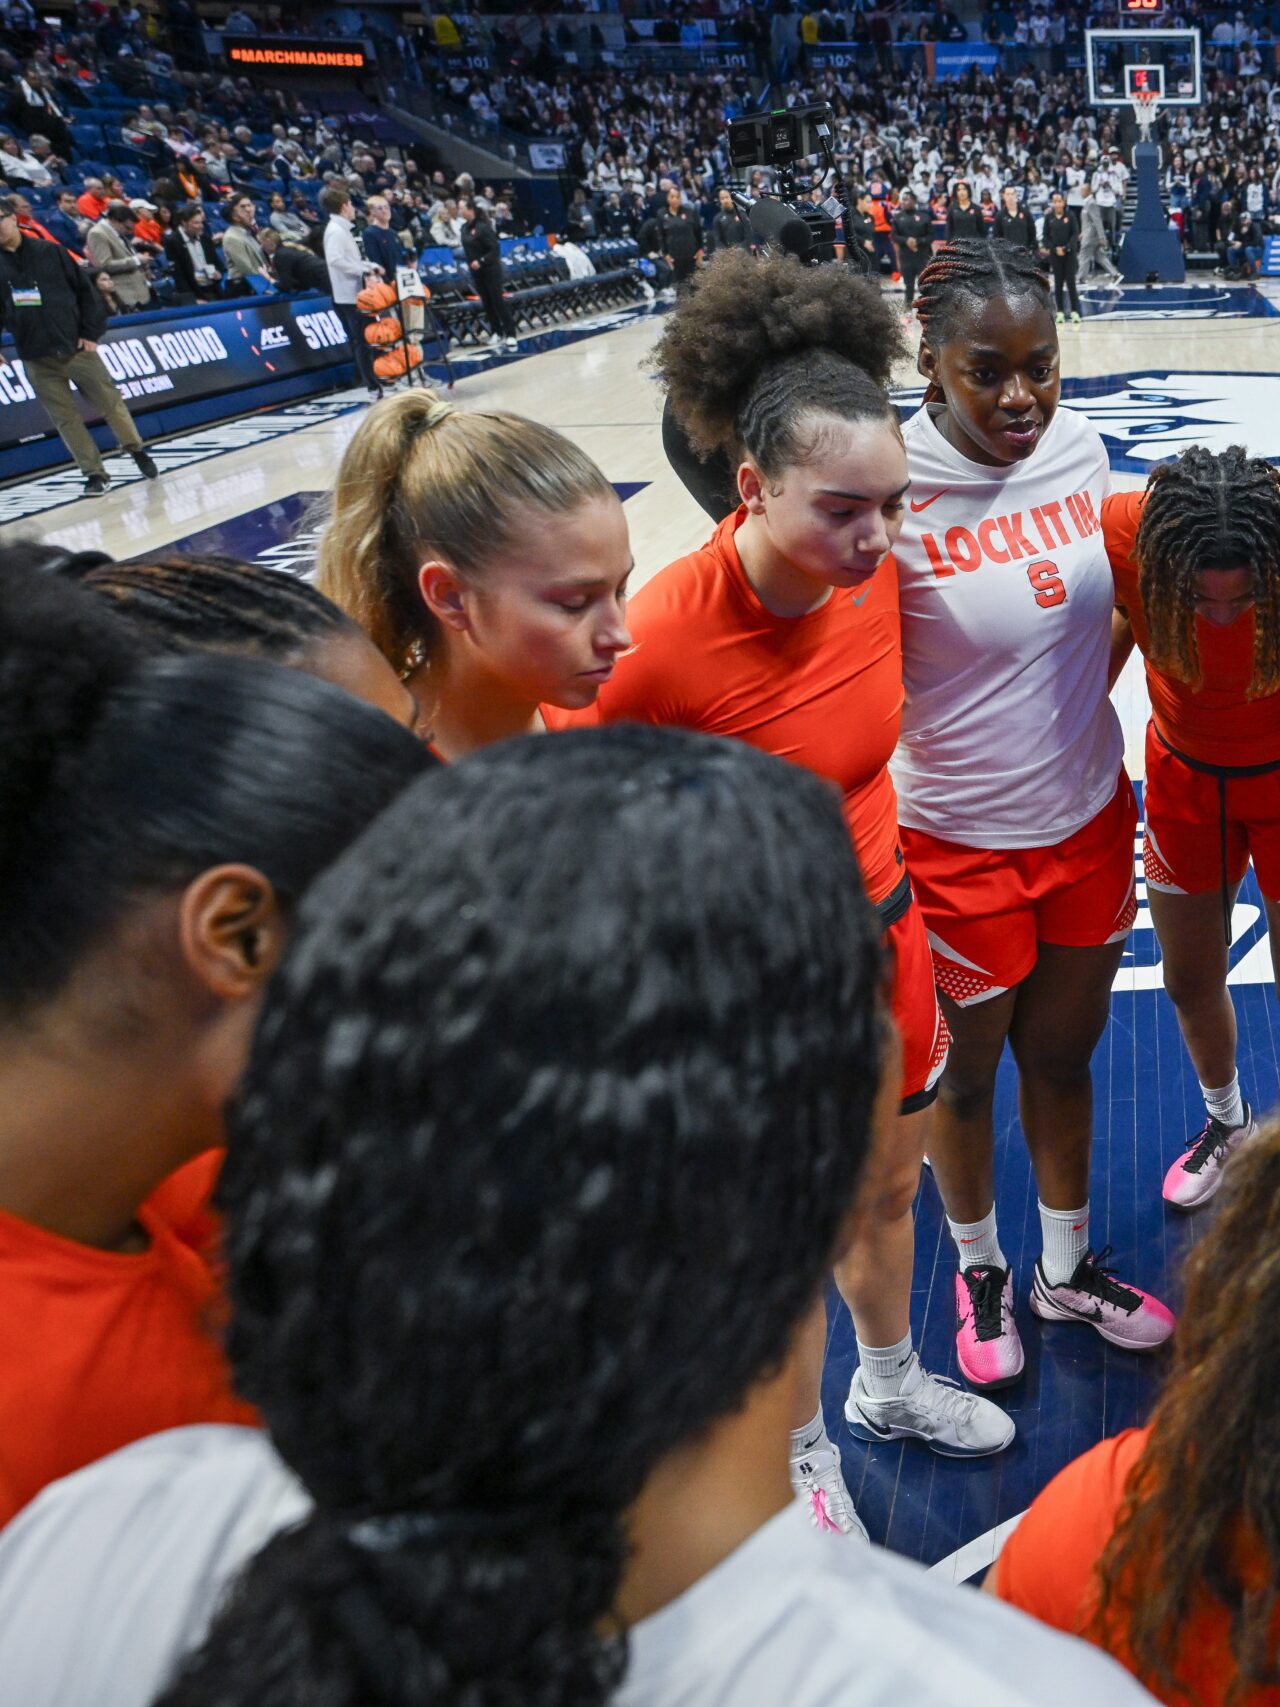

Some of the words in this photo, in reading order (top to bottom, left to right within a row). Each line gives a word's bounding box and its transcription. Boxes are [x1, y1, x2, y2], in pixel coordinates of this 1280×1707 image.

[231, 48, 364, 67] #MARCHMADNESS
[146, 325, 228, 371] ROUND
[260, 326, 290, 347] ACC
[921, 511, 1040, 579] LOCK
[1029, 500, 1072, 551] IT
[1065, 489, 1100, 539] IN
[1027, 559, 1067, 609] S
